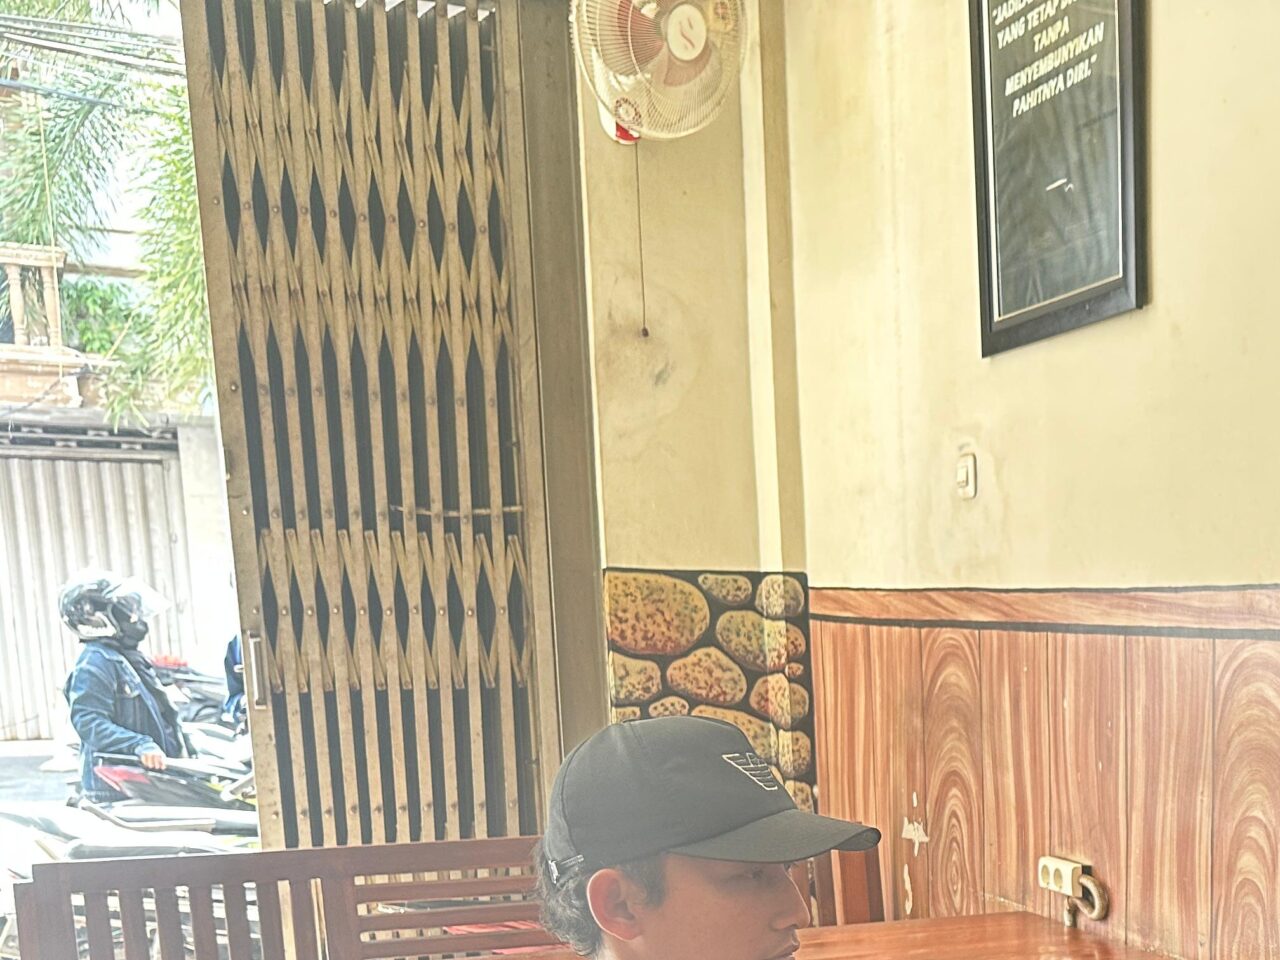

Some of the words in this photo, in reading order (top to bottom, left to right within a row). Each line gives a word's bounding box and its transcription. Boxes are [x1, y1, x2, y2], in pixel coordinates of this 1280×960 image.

[997, 16, 1026, 50] YANG
[1027, 0, 1060, 31] TETAP
[1033, 15, 1070, 53] TANPA
[1005, 21, 1104, 97] MENYEMBUNYIKAN
[1012, 73, 1065, 118] PAHITNYA
